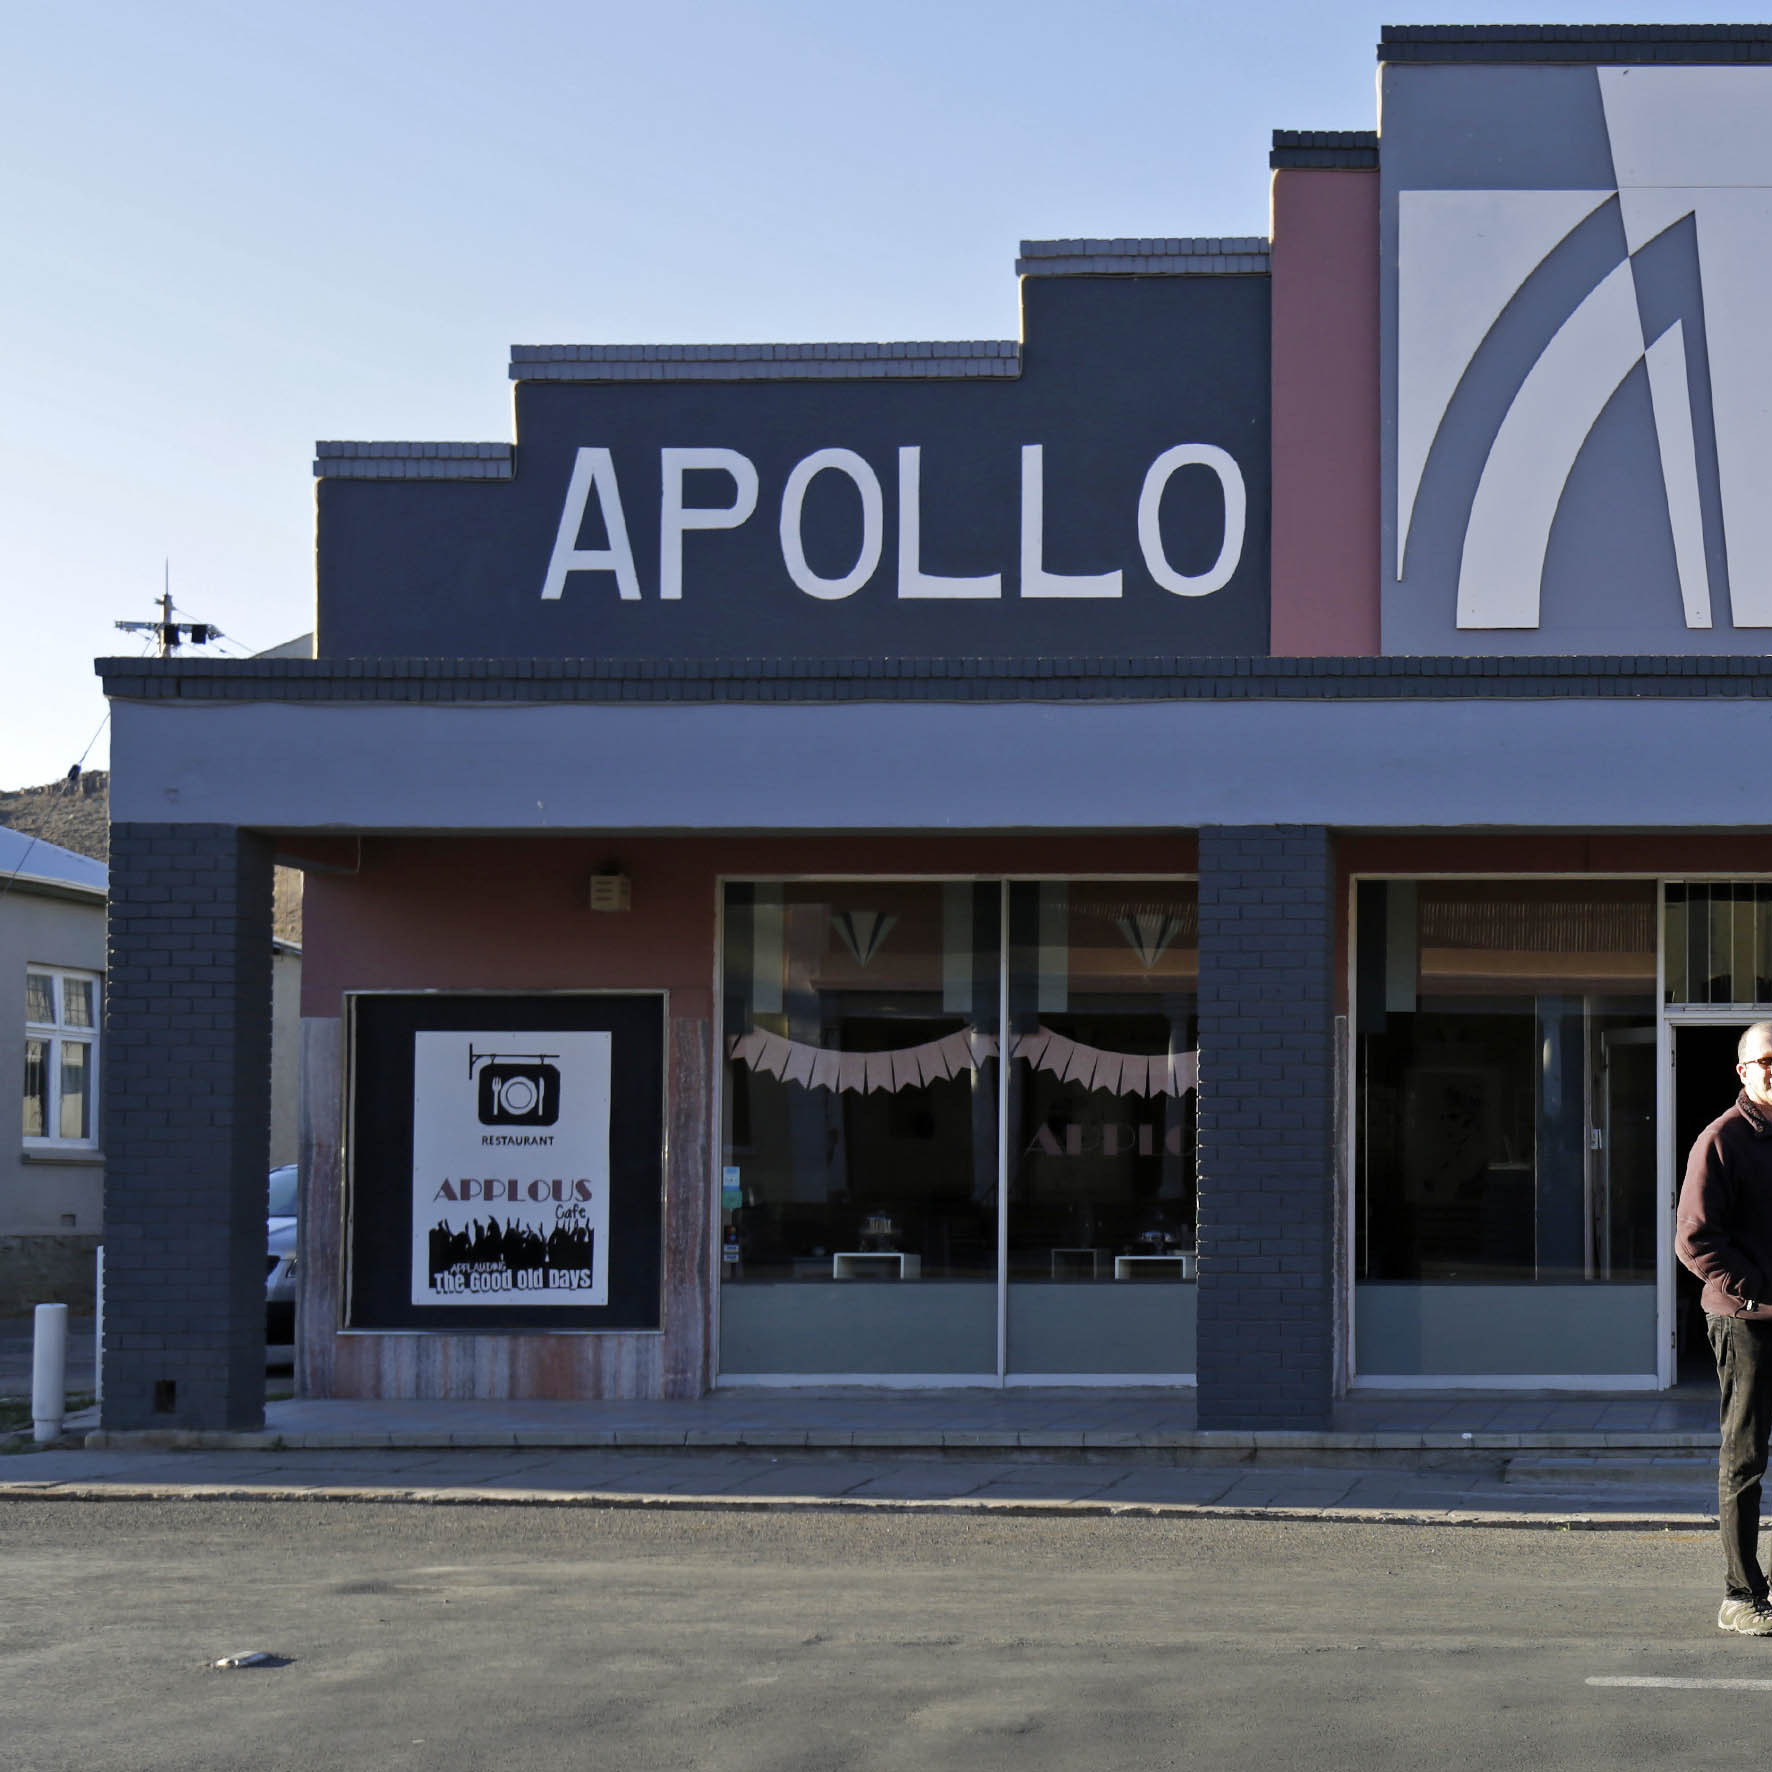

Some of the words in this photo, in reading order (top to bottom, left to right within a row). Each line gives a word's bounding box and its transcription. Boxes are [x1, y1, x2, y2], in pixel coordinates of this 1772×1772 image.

[541, 443, 1247, 600] APOLLO
[481, 1135, 554, 1146] RESTAURANT
[433, 1178, 592, 1202] APPLOUS
[555, 1204, 587, 1219] Cafe
[434, 1270, 465, 1293] The
[469, 1269, 513, 1292] Good
[547, 1268, 592, 1290] Days
